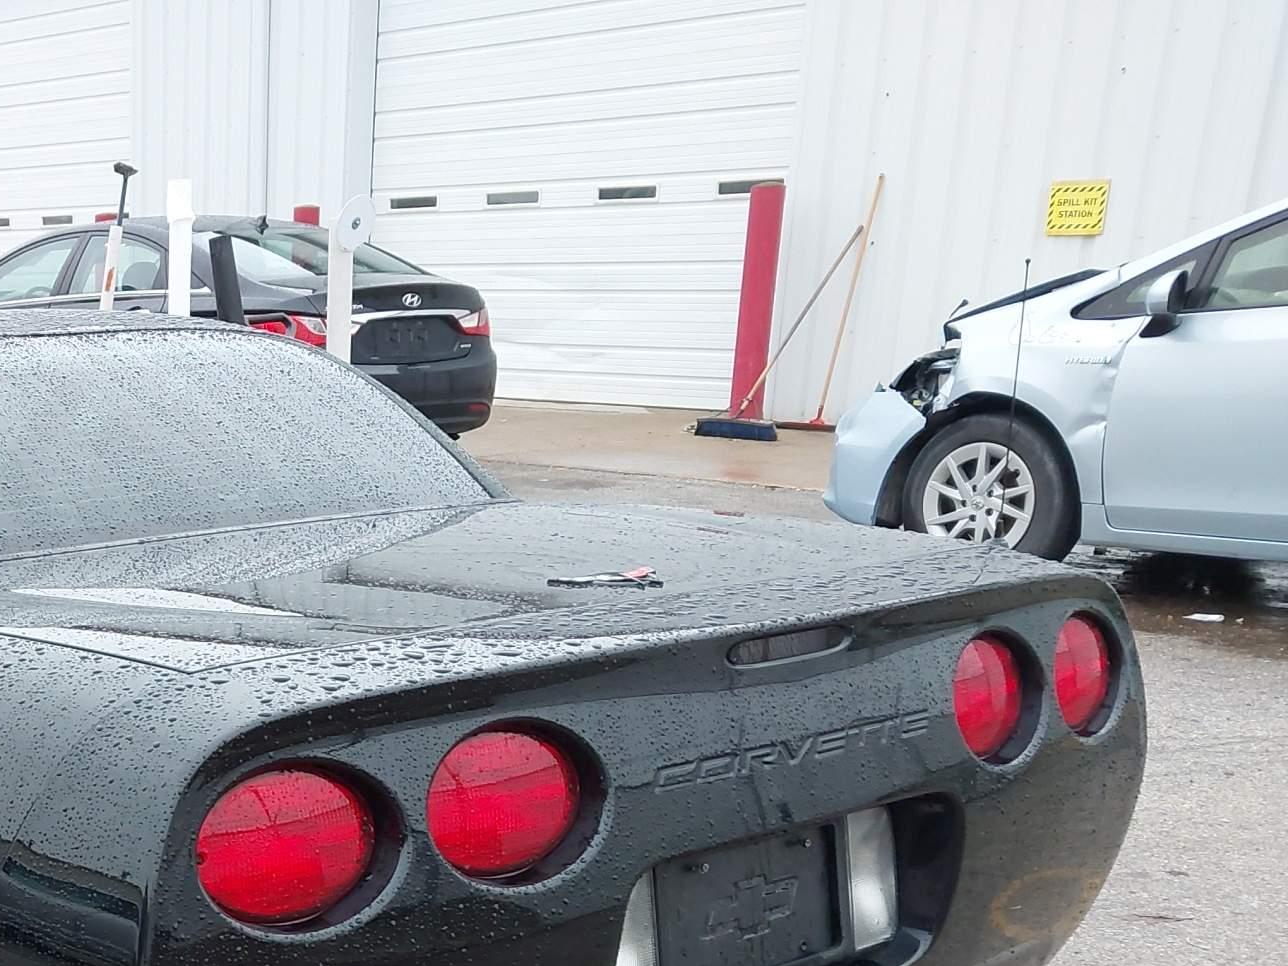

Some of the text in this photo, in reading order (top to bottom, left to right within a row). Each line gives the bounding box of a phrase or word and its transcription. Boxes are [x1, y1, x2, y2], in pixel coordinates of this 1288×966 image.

[1057, 197, 1098, 207] SPILL KIT
[1058, 209, 1093, 218] STATION
[653, 708, 930, 794] CORVETTE
